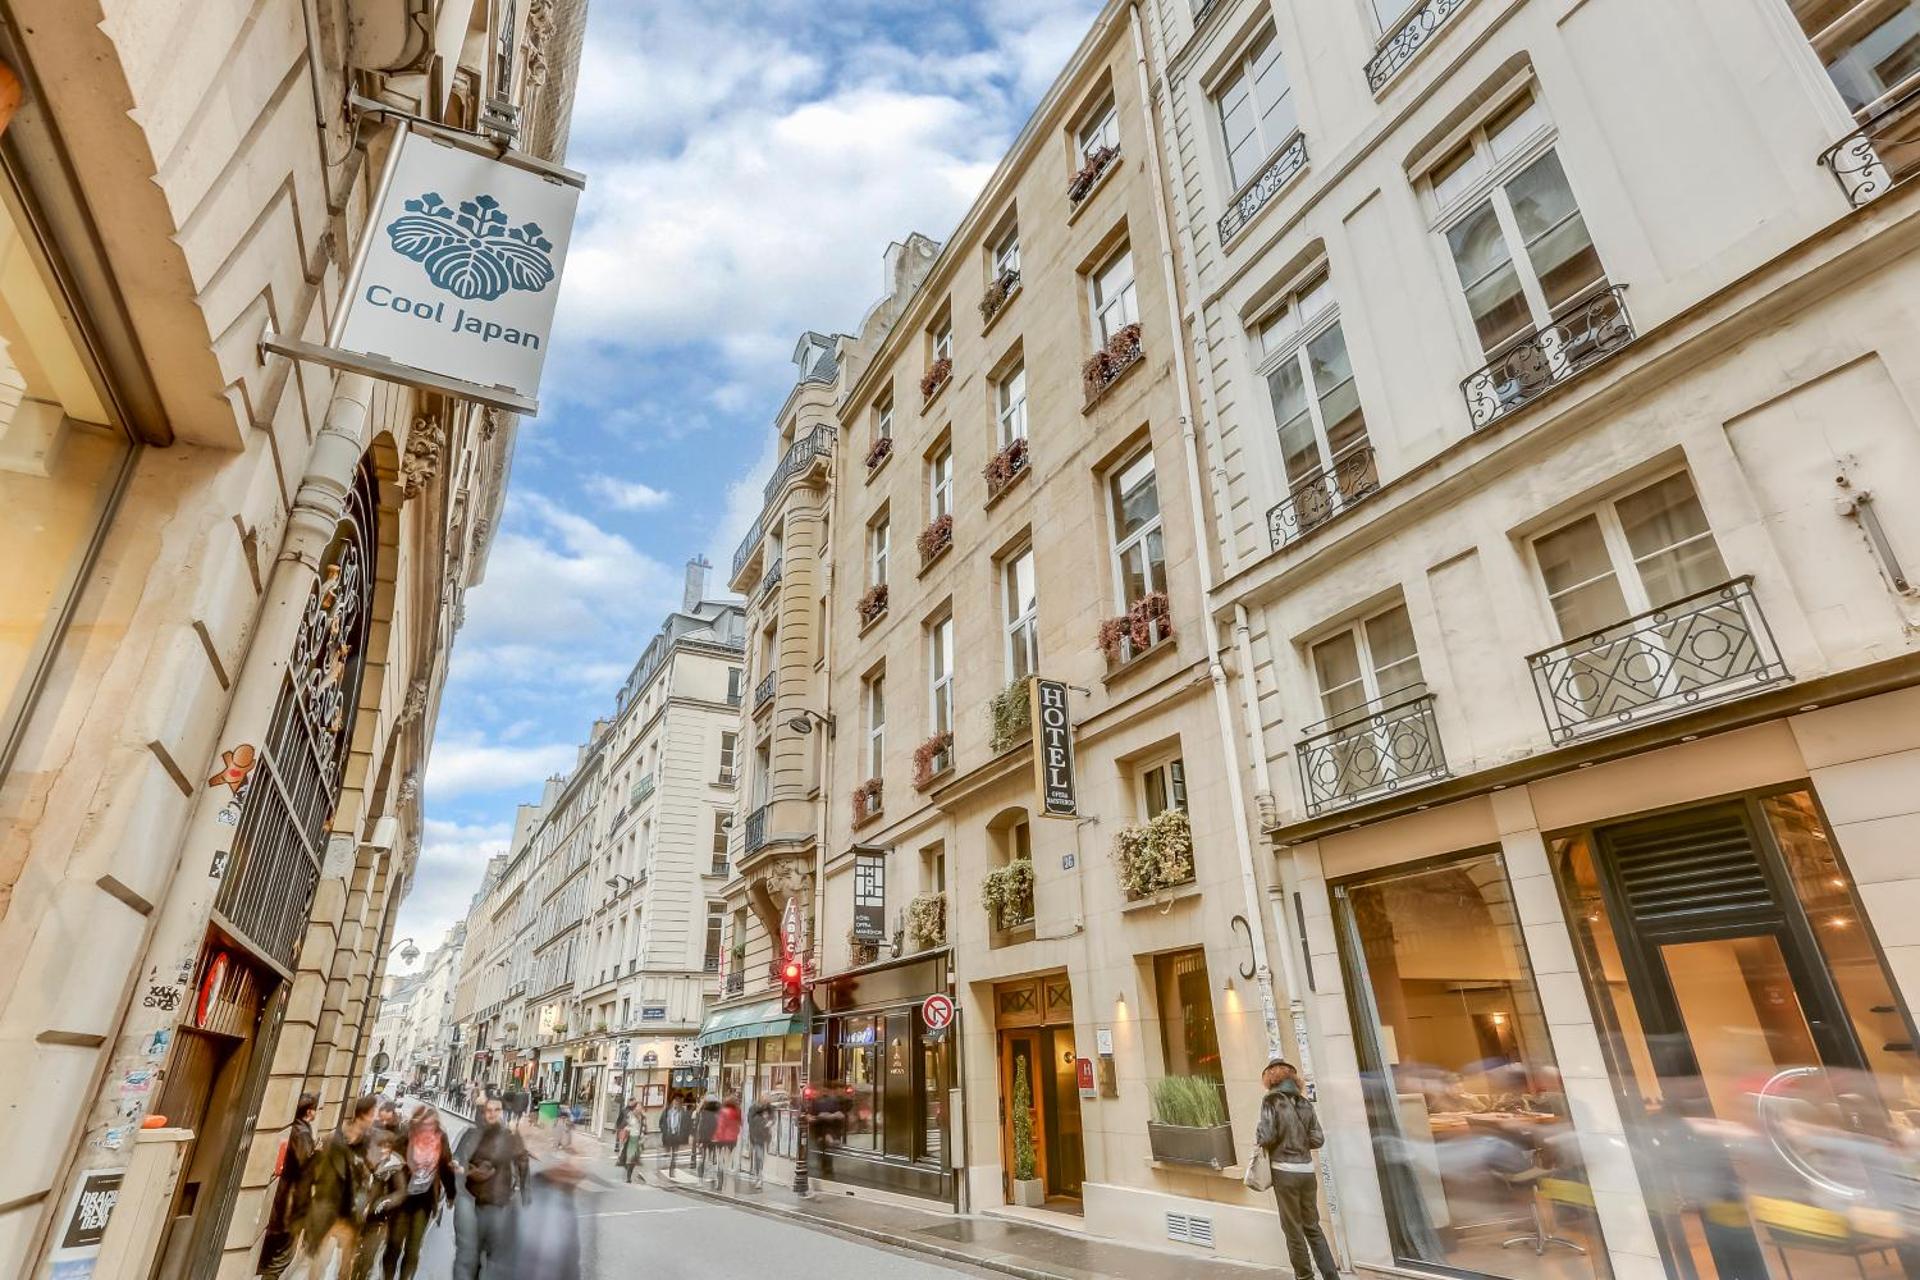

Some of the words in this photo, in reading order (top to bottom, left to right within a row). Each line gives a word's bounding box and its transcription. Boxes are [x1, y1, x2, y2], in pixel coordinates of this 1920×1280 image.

[365, 284, 445, 324] Cool
[452, 308, 540, 350] Japan
[1041, 687, 1067, 788] HOTEL
[787, 906, 796, 952] TABAC
